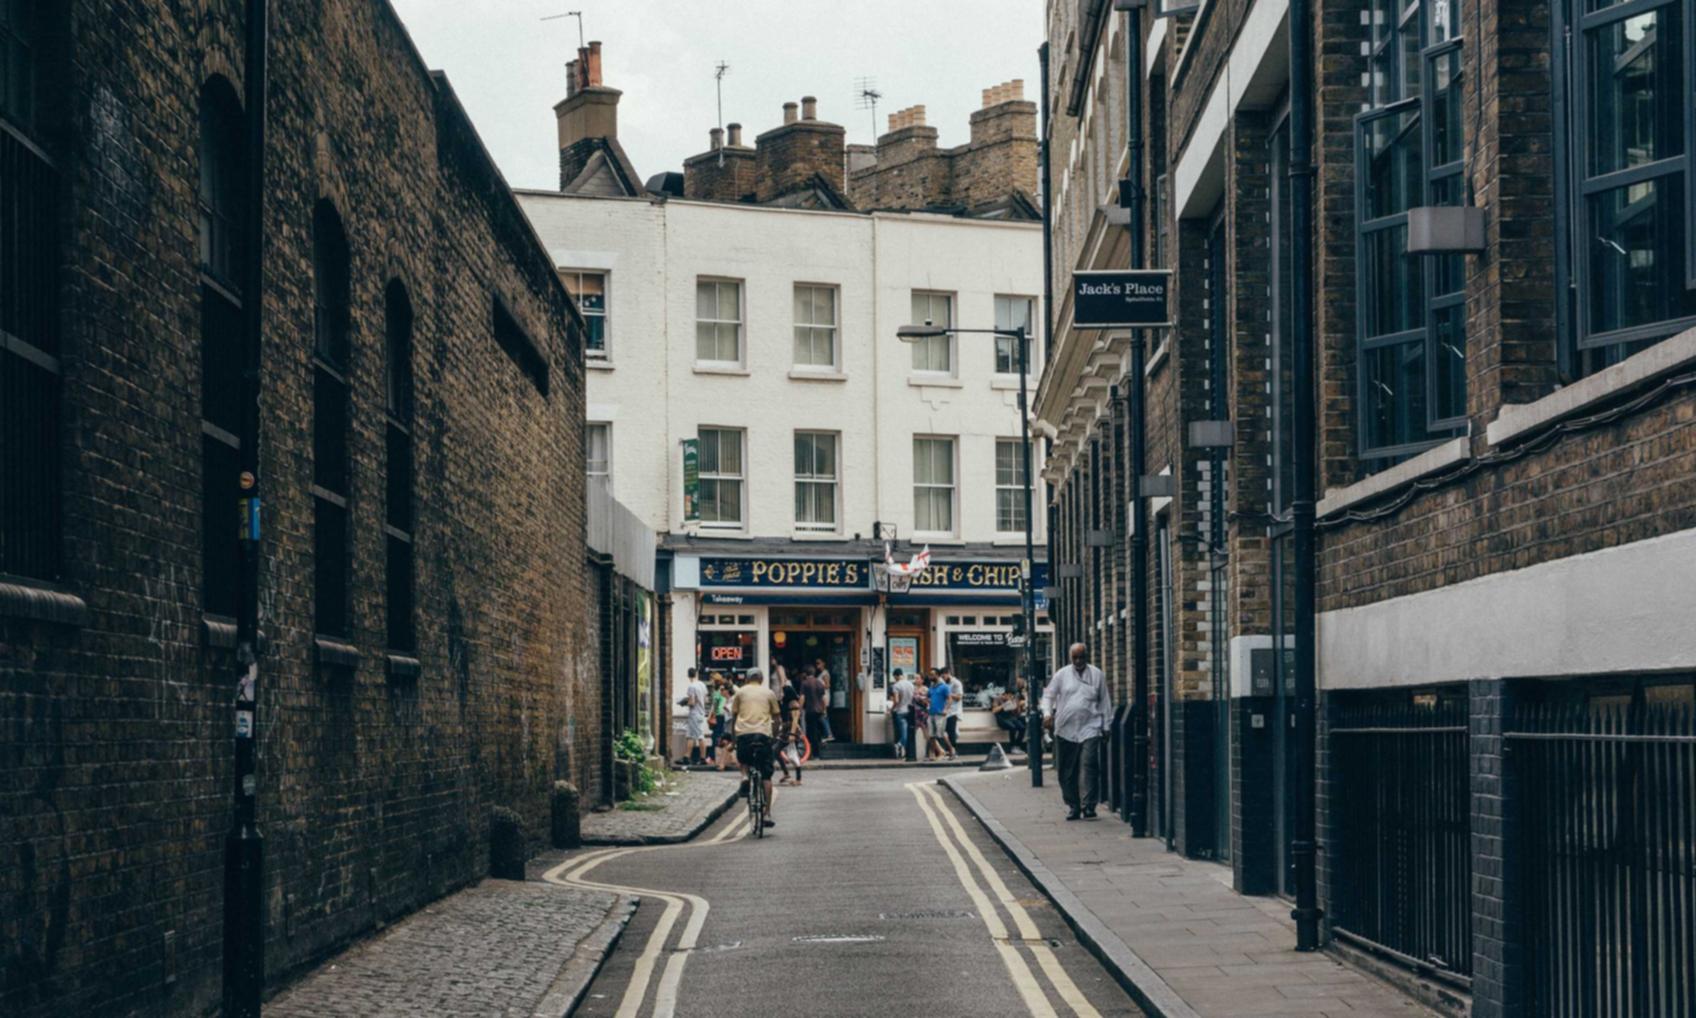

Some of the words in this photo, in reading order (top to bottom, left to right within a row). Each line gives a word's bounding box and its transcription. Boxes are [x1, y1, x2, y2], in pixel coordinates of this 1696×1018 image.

[1079, 282, 1121, 295] Jack's
[1124, 282, 1164, 295] Place
[752, 560, 858, 584] POPPIE'S
[952, 567, 963, 582] &
[967, 565, 1021, 586] CHIP
[958, 633, 992, 641] WELCOME
[993, 633, 1003, 641] TO
[712, 647, 742, 660] OPEN
